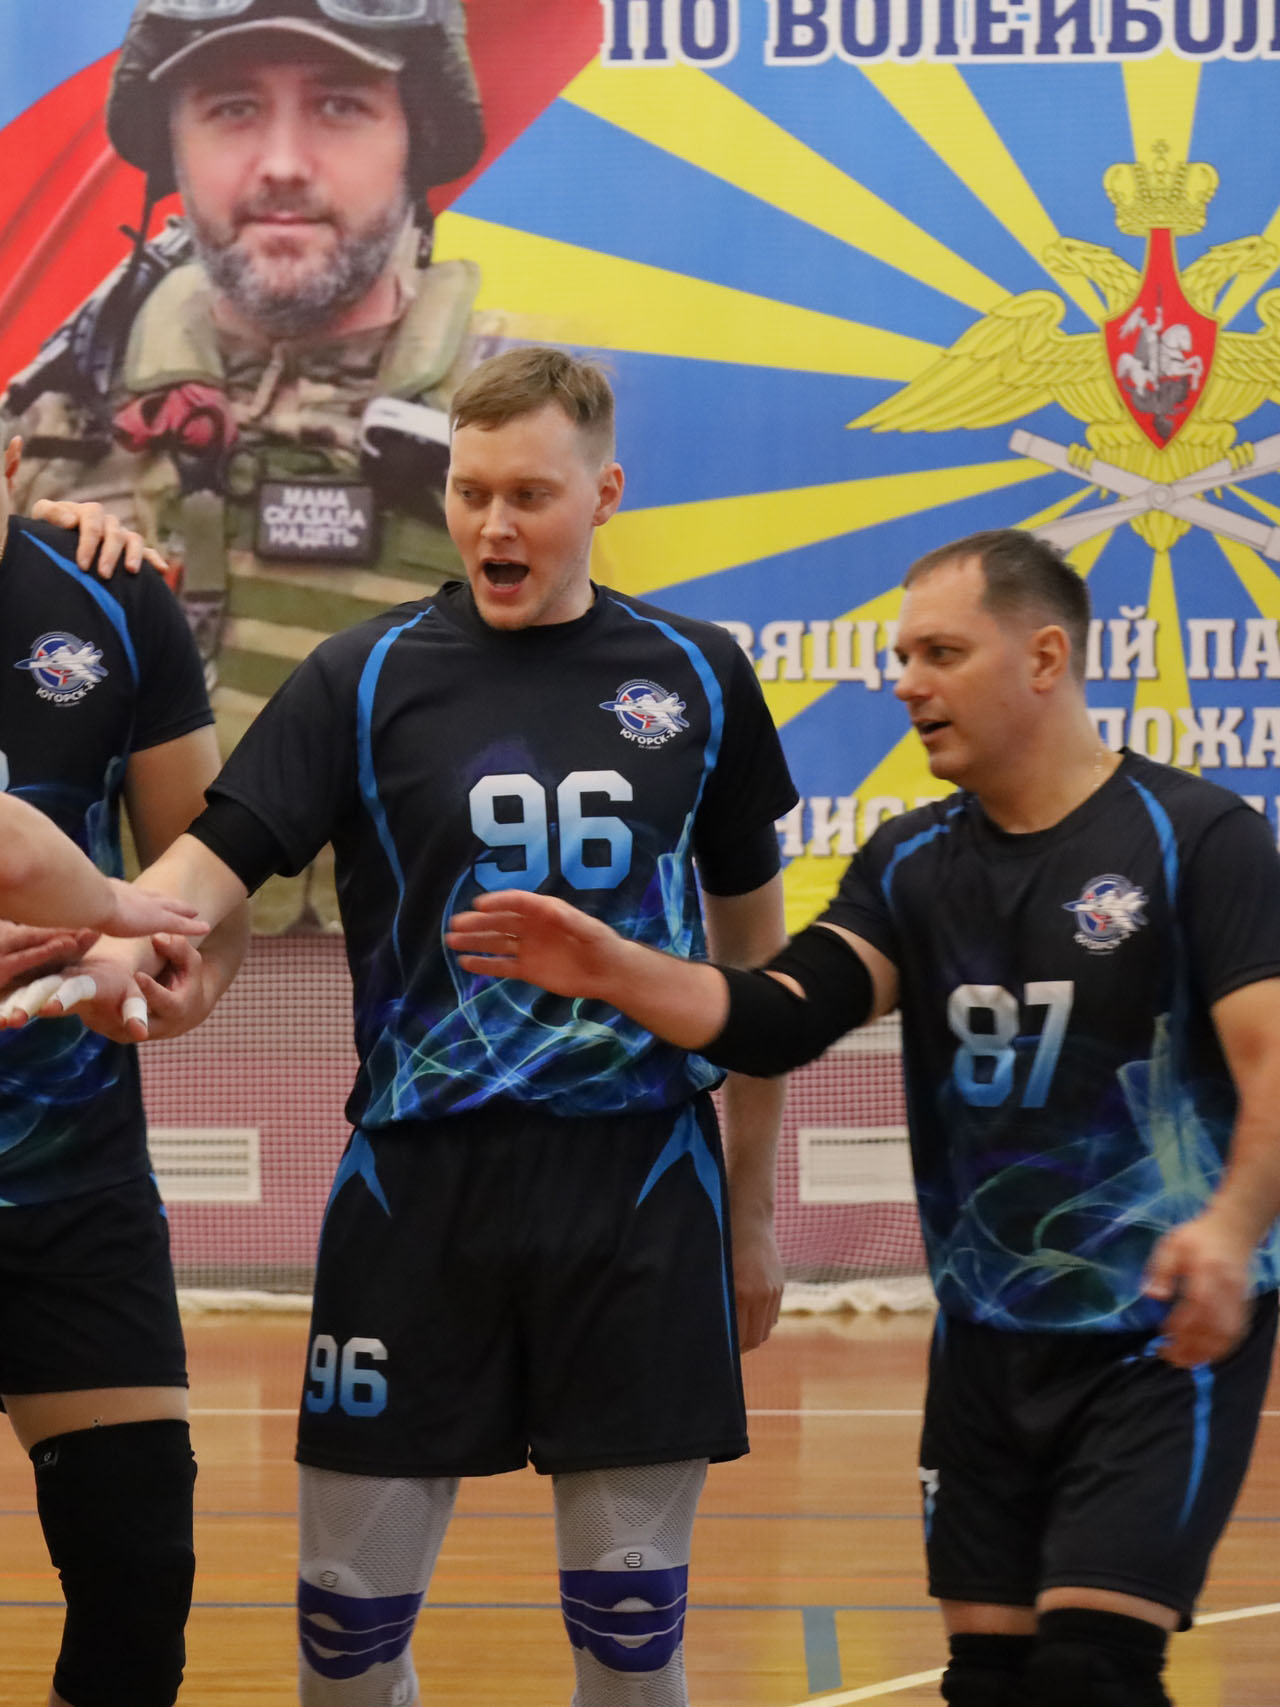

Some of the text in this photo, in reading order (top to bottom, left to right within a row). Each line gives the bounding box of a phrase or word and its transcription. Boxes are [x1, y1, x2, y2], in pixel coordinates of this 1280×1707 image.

[608, 0, 731, 61] ПО
[469, 770, 633, 892] 96
[948, 980, 1075, 1108] 87
[306, 1334, 389, 1418] 96
